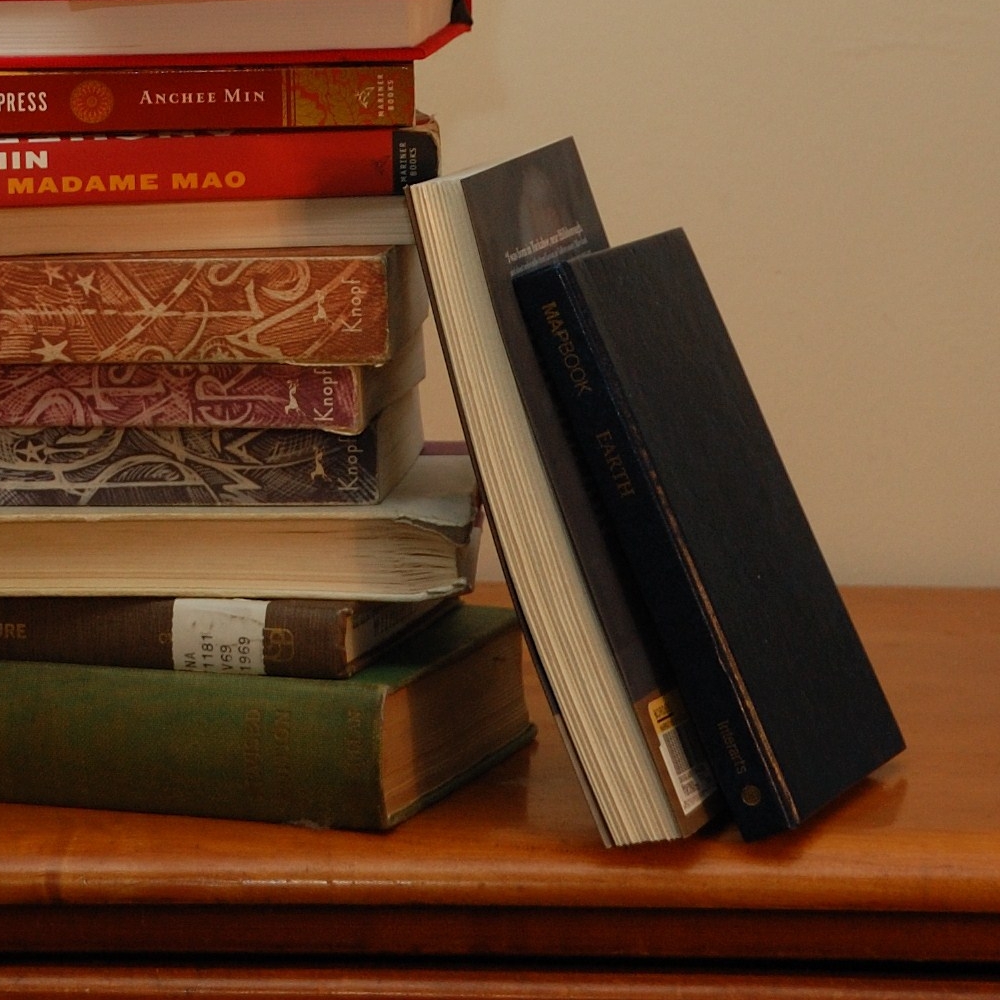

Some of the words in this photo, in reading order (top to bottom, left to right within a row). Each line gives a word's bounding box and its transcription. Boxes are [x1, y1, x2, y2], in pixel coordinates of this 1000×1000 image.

[140, 90, 216, 105] ANCHEE
[224, 88, 265, 103] MIN
[399, 142, 408, 183] MARINER
[409, 147, 417, 177] BOOKS
[7, 173, 159, 197] MADAME
[171, 170, 247, 191] MAO
[341, 276, 367, 332] Knopf
[541, 300, 590, 397] MAPBOOK
[313, 368, 339, 421] Knopf
[595, 430, 635, 499] EARTH
[184, 651, 196, 670] NA
[201, 630, 214, 668] 1181
[220, 644, 233, 671] V69
[238, 636, 251, 671] 1969
